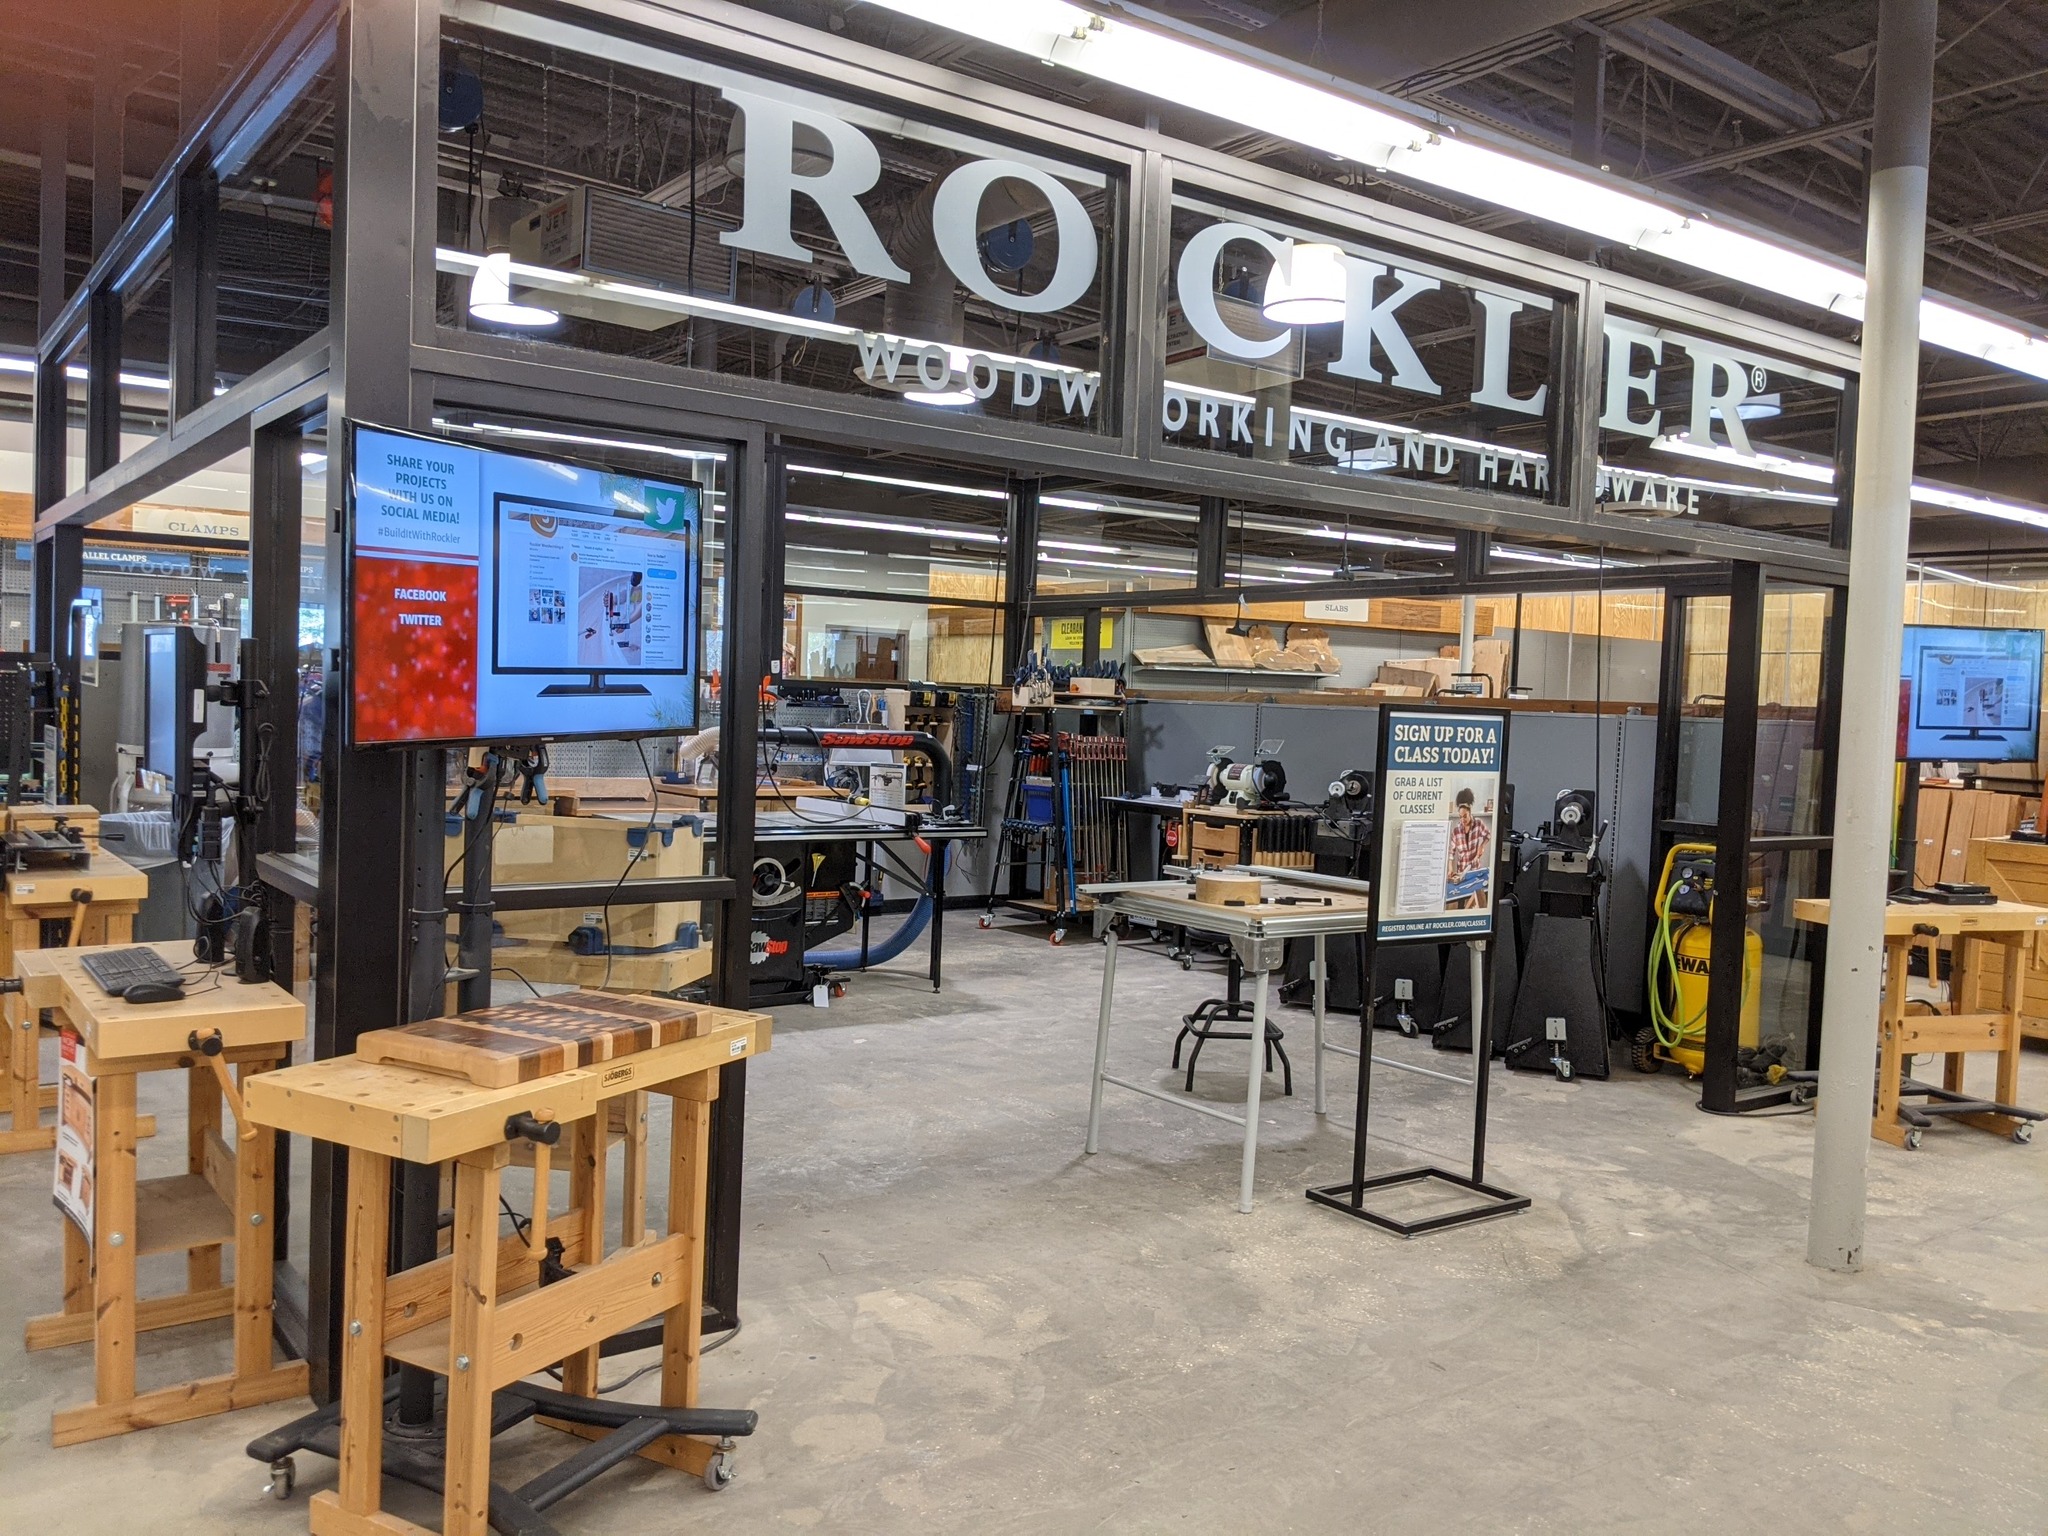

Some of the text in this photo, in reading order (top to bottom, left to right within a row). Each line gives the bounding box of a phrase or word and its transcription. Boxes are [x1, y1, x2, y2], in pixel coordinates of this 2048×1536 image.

[1372, 430, 1454, 475] AND
[387, 454, 455, 475] SHARE YOUR
[395, 472, 447, 489] PROJECTS
[388, 488, 453, 507] WITH US ON
[381, 504, 460, 524] SOCIAL MEDIA!
[168, 521, 240, 536] CLAMPS
[378, 526, 461, 544] #BuildItWithRockler
[82, 551, 148, 562] ALLEL CLAMPS
[394, 587, 447, 602] FACEBOOK
[1324, 604, 1349, 612] SLABS
[398, 613, 442, 626] TWITTER
[820, 732, 915, 747] SawStop
[1394, 724, 1497, 744] SIGN UP FOR A
[1394, 746, 1494, 764] CLASS TODAY!
[1394, 777, 1443, 787] GRAB A LIST
[1393, 791, 1443, 801] OF CURRENT
[1400, 803, 1435, 814] CLASSES!
[1381, 924, 1406, 932] REGISTER
[1406, 923, 1425, 931] ONLINE
[1432, 919, 1487, 929] ROCKLER.COM/CLASSES
[751, 940, 789, 955] awStop
[604, 1066, 632, 1083] SJÖBERGS
